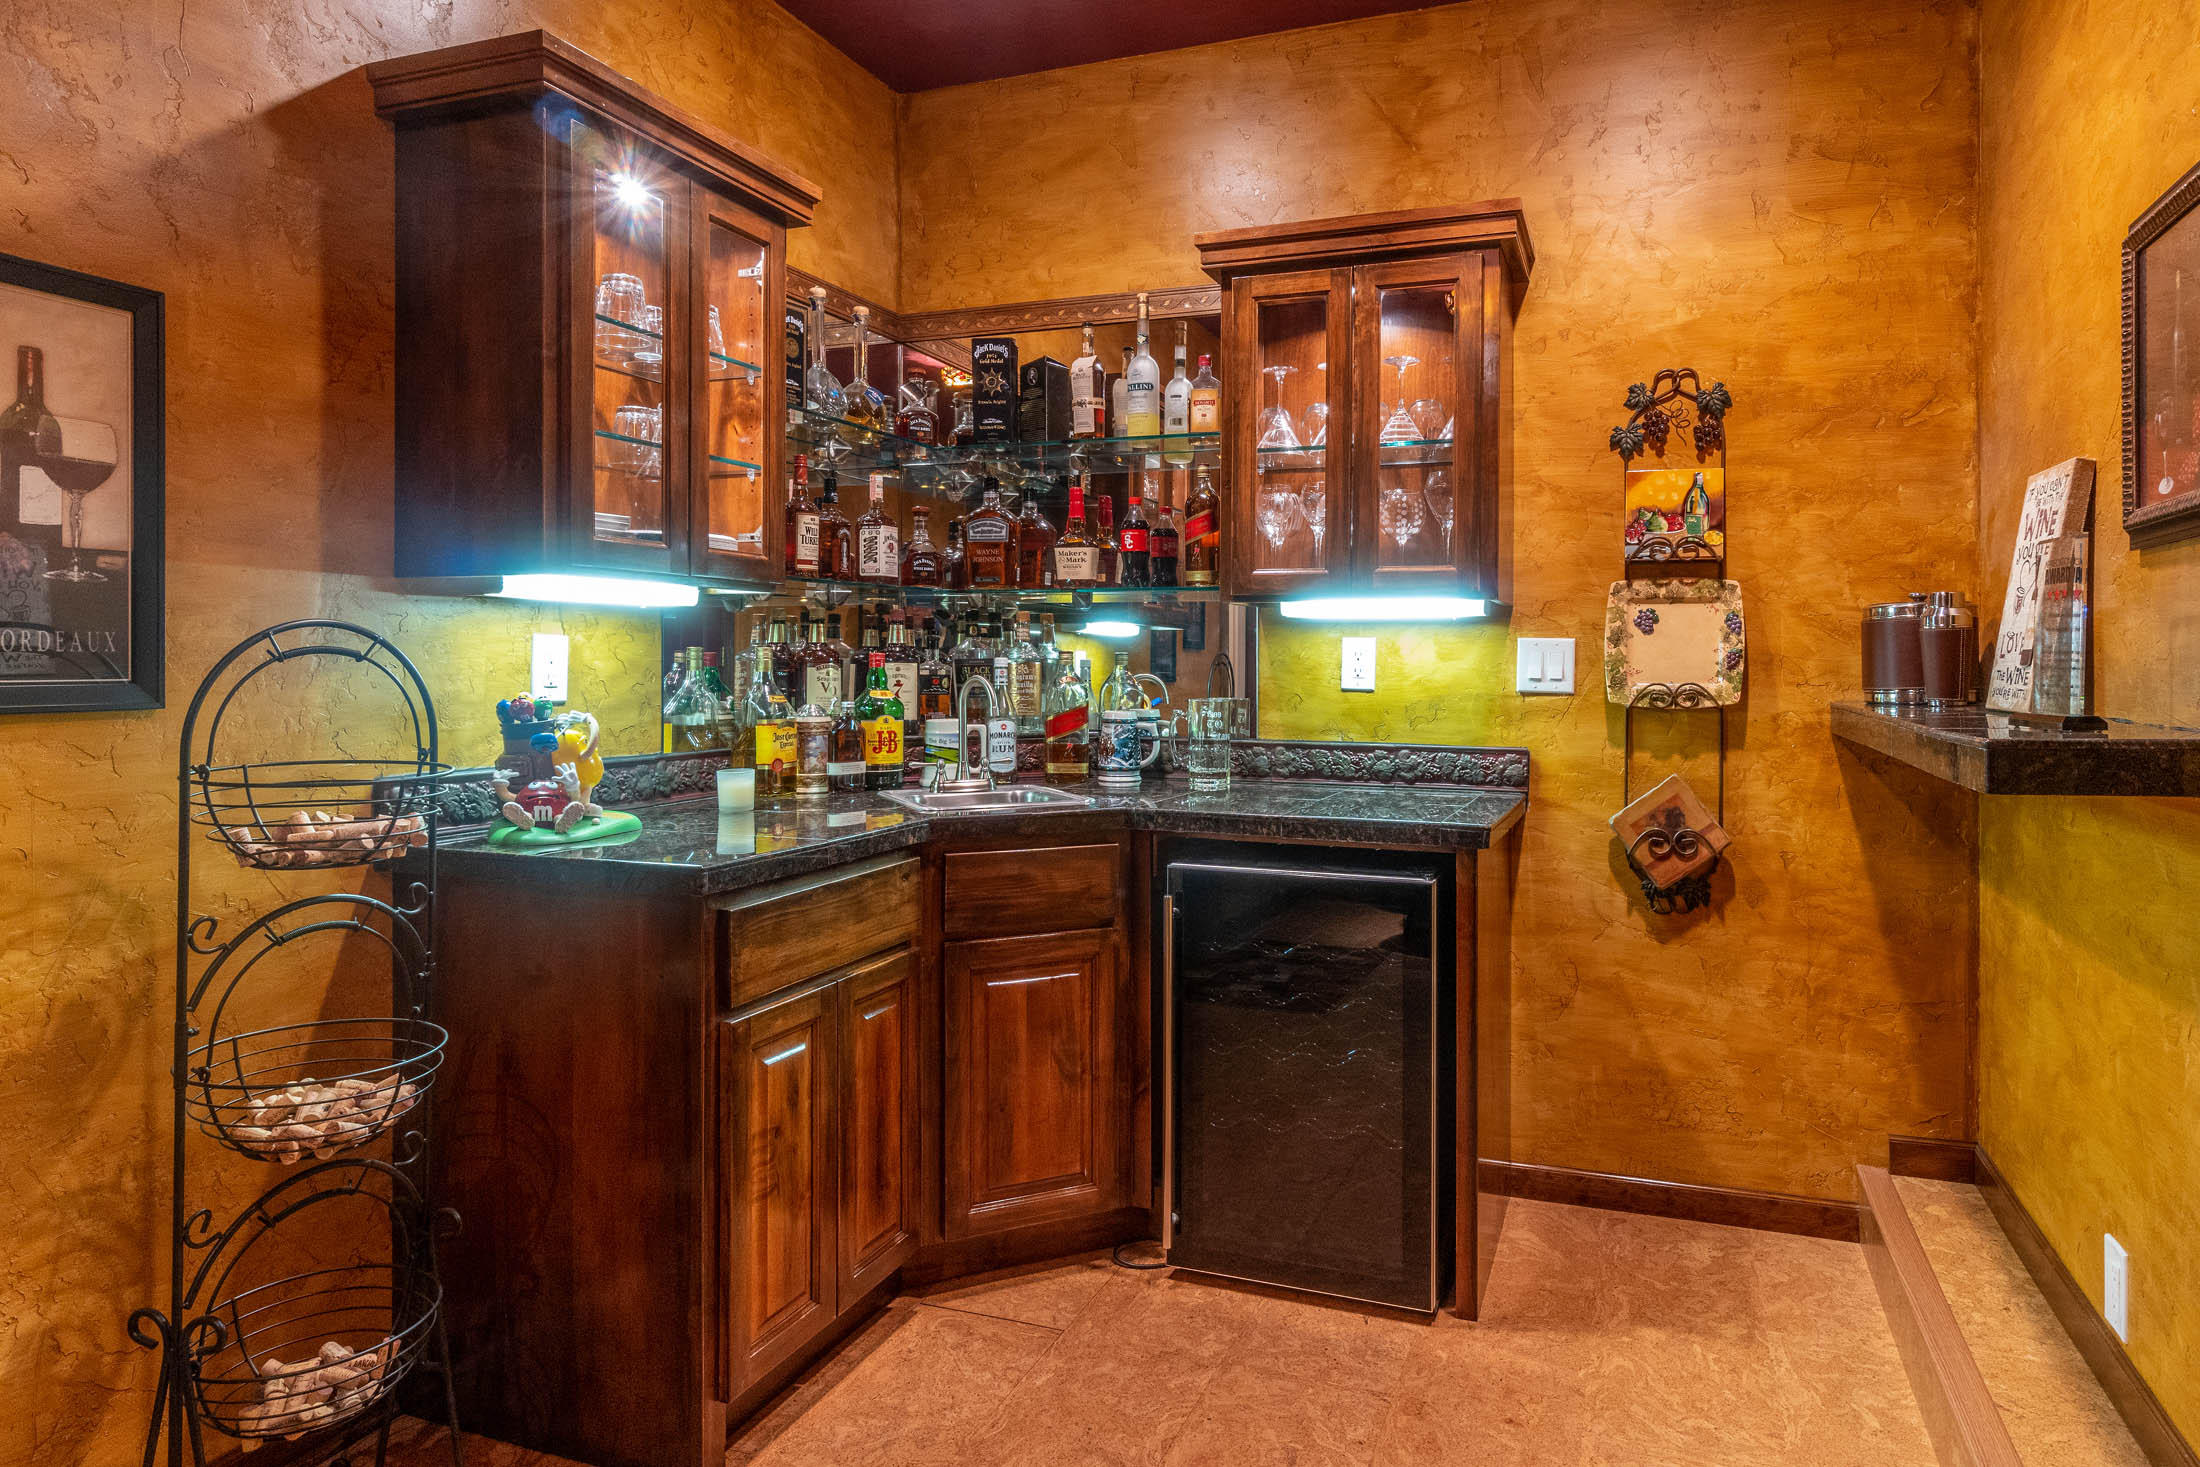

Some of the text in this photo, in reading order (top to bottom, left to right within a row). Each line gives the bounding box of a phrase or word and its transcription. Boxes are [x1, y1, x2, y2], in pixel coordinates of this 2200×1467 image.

[1128, 383, 1152, 391] ALLINI
[2035, 482, 2048, 497] YOU
[0, 629, 116, 653] ORDEAUX
[989, 732, 1016, 740] MONARC
[991, 745, 1015, 753] RUM
